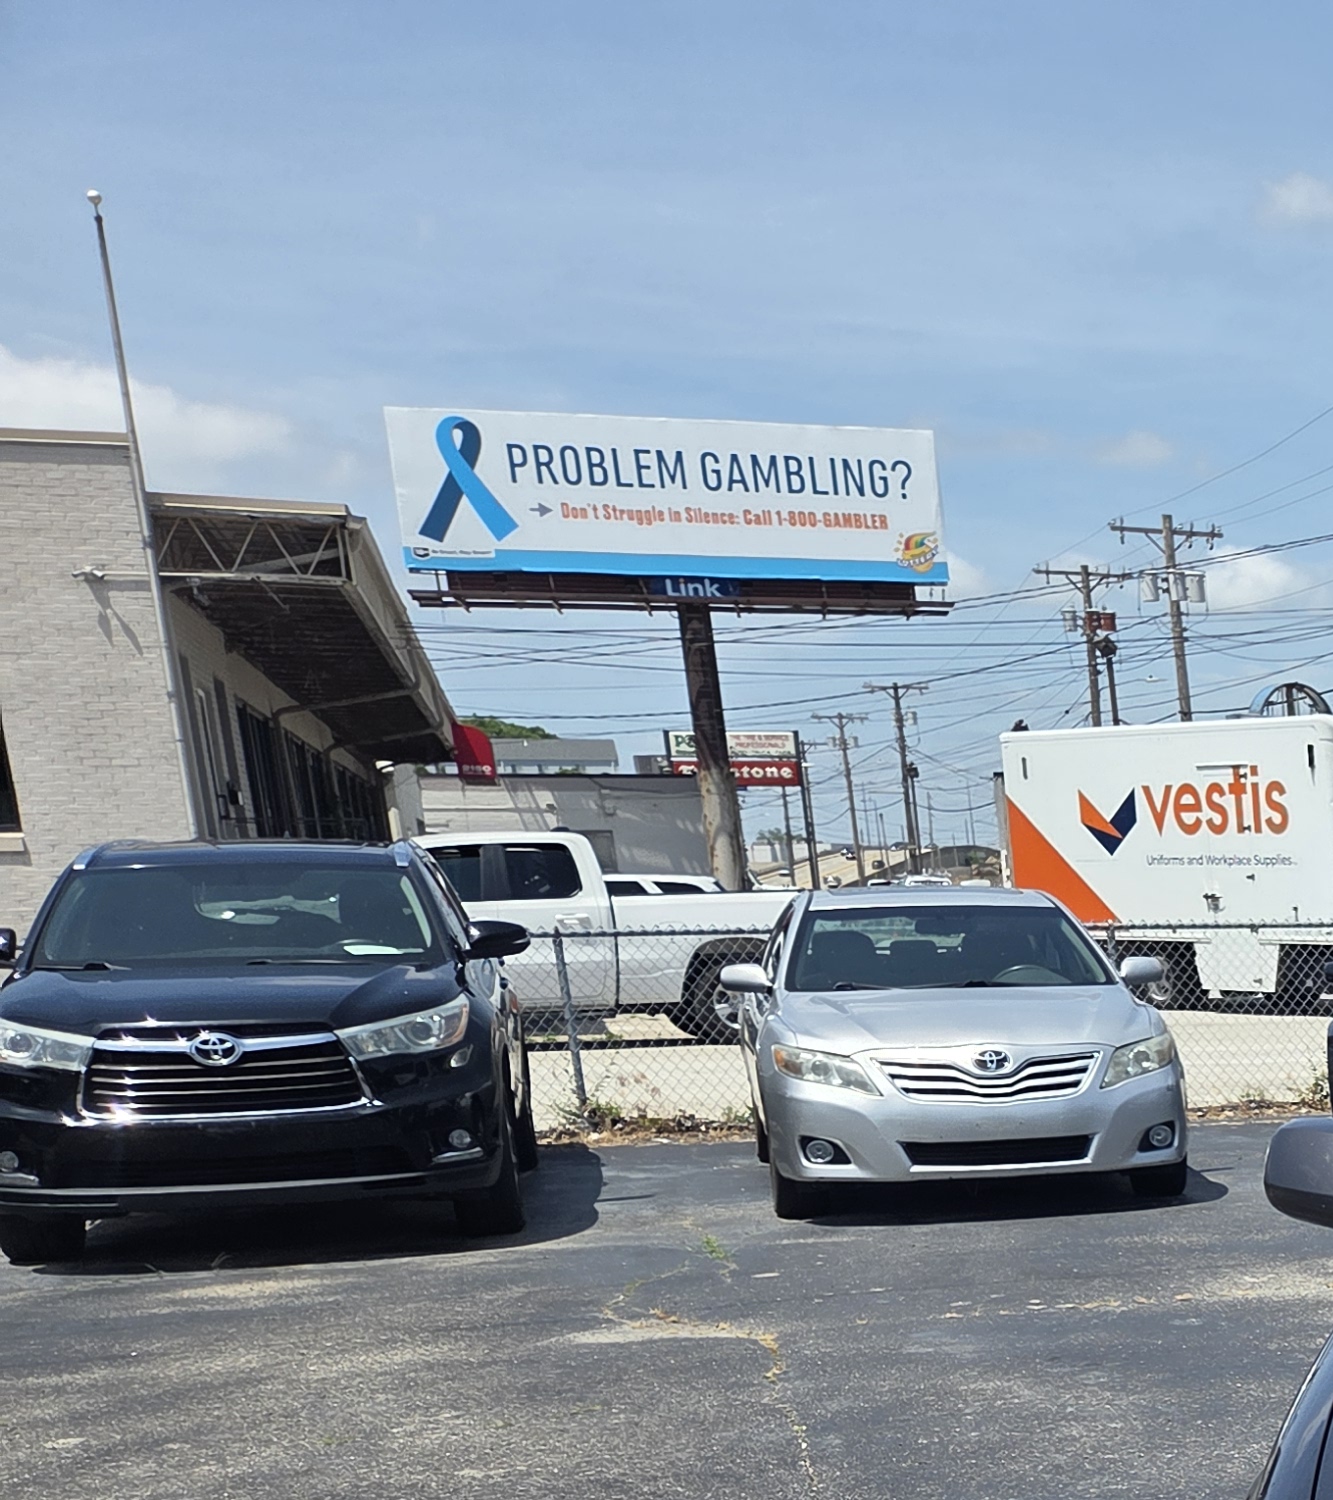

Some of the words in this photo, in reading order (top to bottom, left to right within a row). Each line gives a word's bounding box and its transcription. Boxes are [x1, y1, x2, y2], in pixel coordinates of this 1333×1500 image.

[506, 443, 688, 490] PROBLEM
[699, 451, 912, 500] GAMBLING?
[560, 502, 599, 520] Don't
[602, 503, 665, 526] Struggle
[668, 506, 682, 523] in
[684, 506, 741, 526] Silence:
[743, 508, 772, 526] Call
[775, 509, 889, 531] 1-800-GAMBLER
[665, 578, 723, 598] Link
[1141, 764, 1290, 837] vestis
[1146, 854, 1185, 866] Uniforms
[1187, 854, 1203, 866] and
[1204, 854, 1251, 868] Workplace
